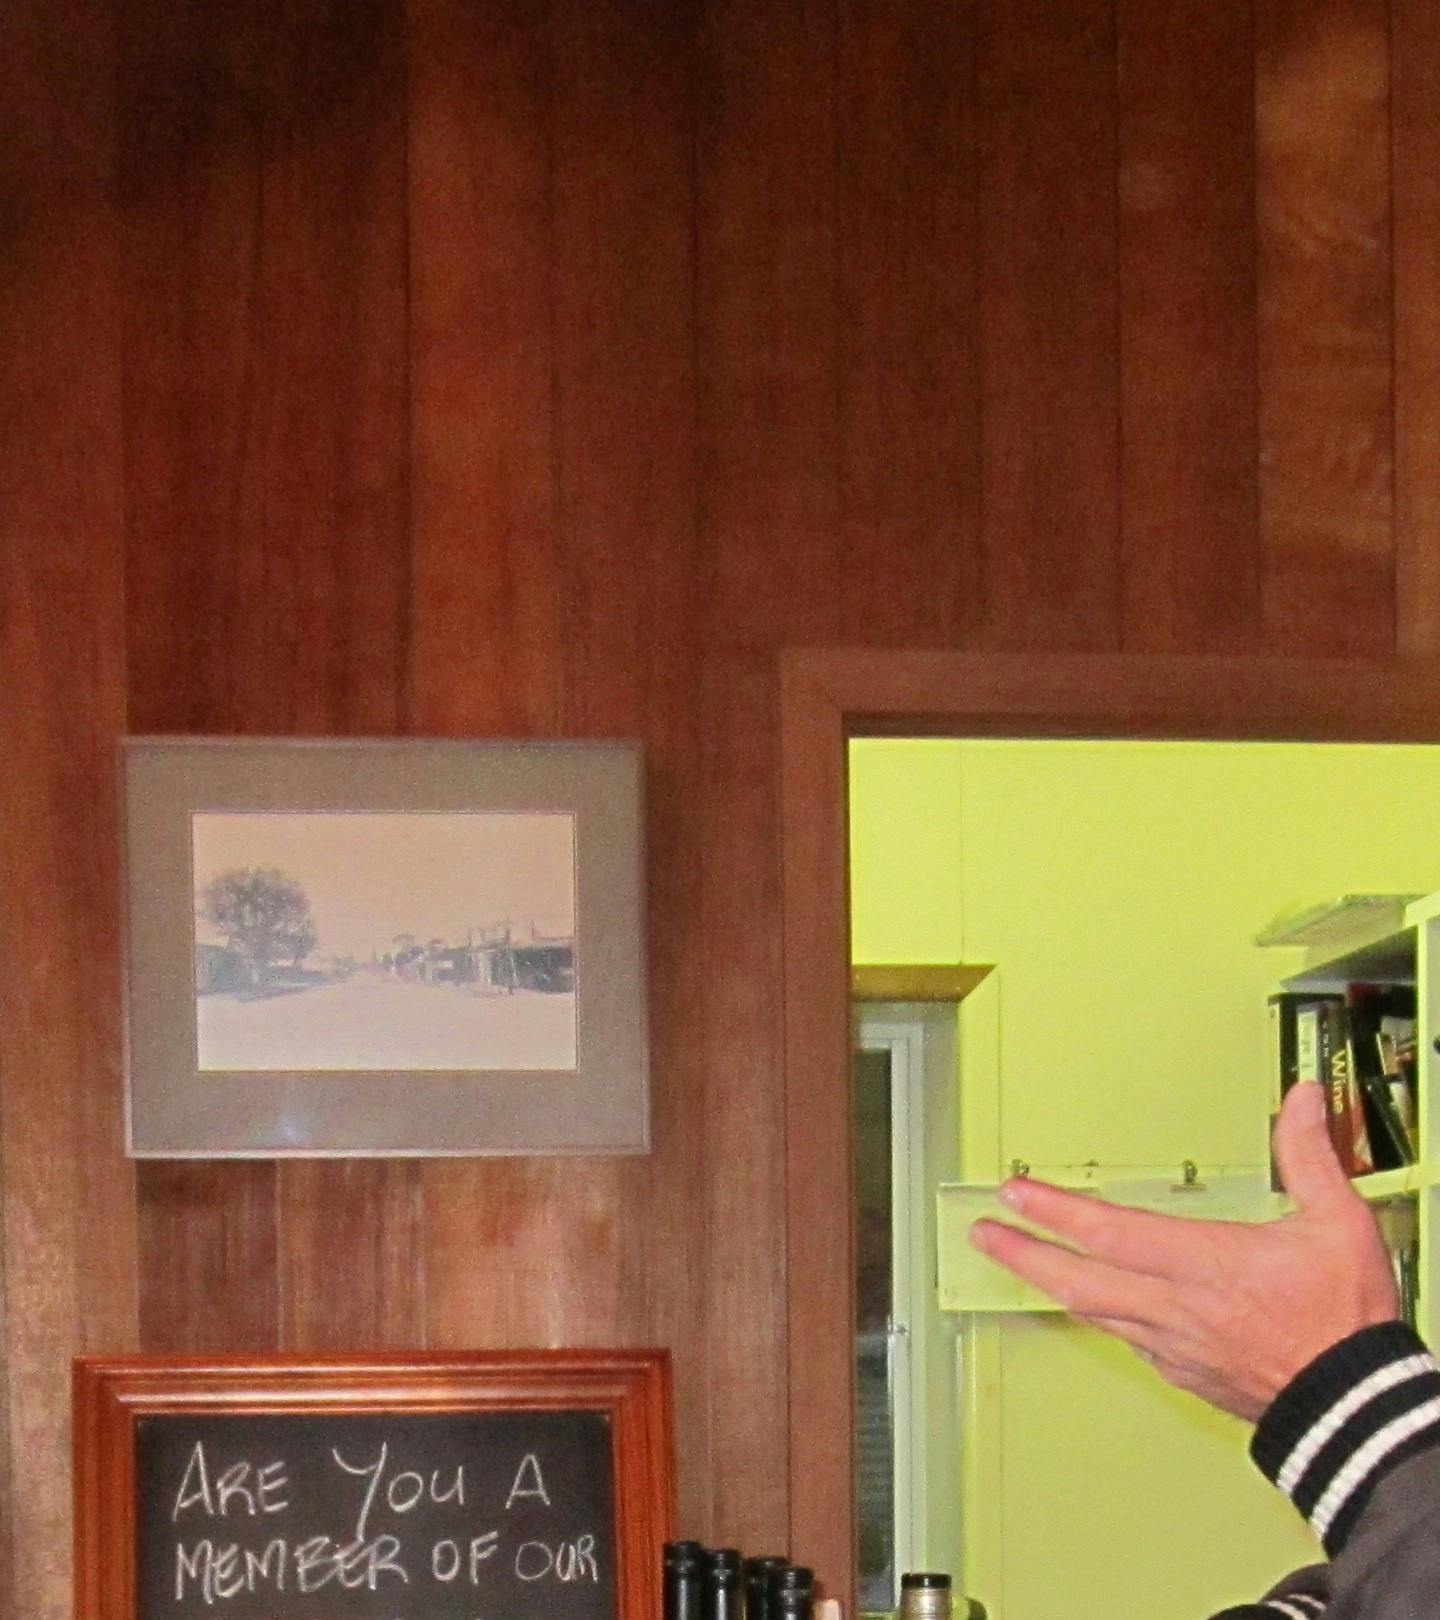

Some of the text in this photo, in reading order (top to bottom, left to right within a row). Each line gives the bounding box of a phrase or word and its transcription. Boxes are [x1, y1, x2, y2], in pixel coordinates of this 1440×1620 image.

[1331, 1049, 1347, 1115] Wine
[172, 1439, 551, 1544] ARE YOU A
[175, 1530, 598, 1605] MEMBER OF OUR
